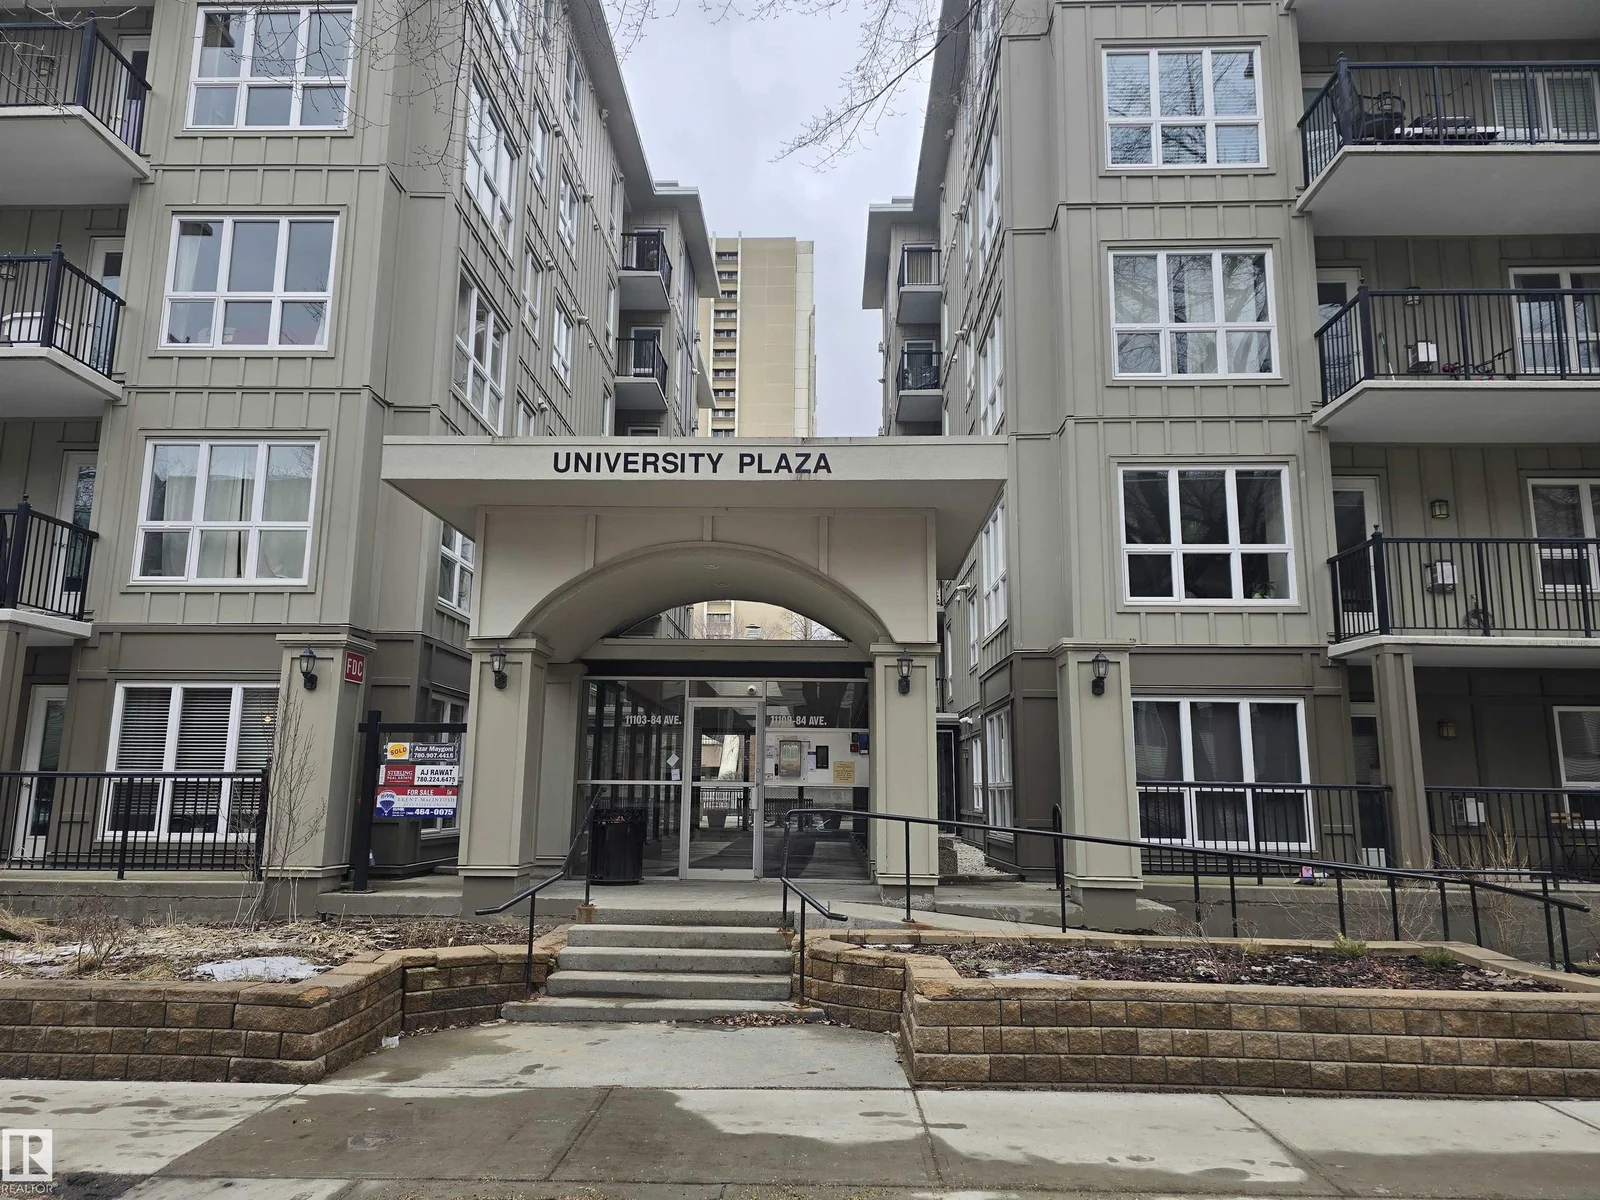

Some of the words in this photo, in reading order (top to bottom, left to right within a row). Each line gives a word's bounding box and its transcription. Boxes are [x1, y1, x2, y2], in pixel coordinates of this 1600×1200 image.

[553, 451, 724, 474] UNIVERSITY
[738, 452, 832, 474] PLAZA
[346, 657, 363, 677] FDC
[624, 715, 662, 725] 11103-84
[663, 715, 682, 725] AVE.
[808, 715, 827, 726] AVE.
[390, 746, 408, 756] SOLD
[414, 808, 454, 816] 464-0075
